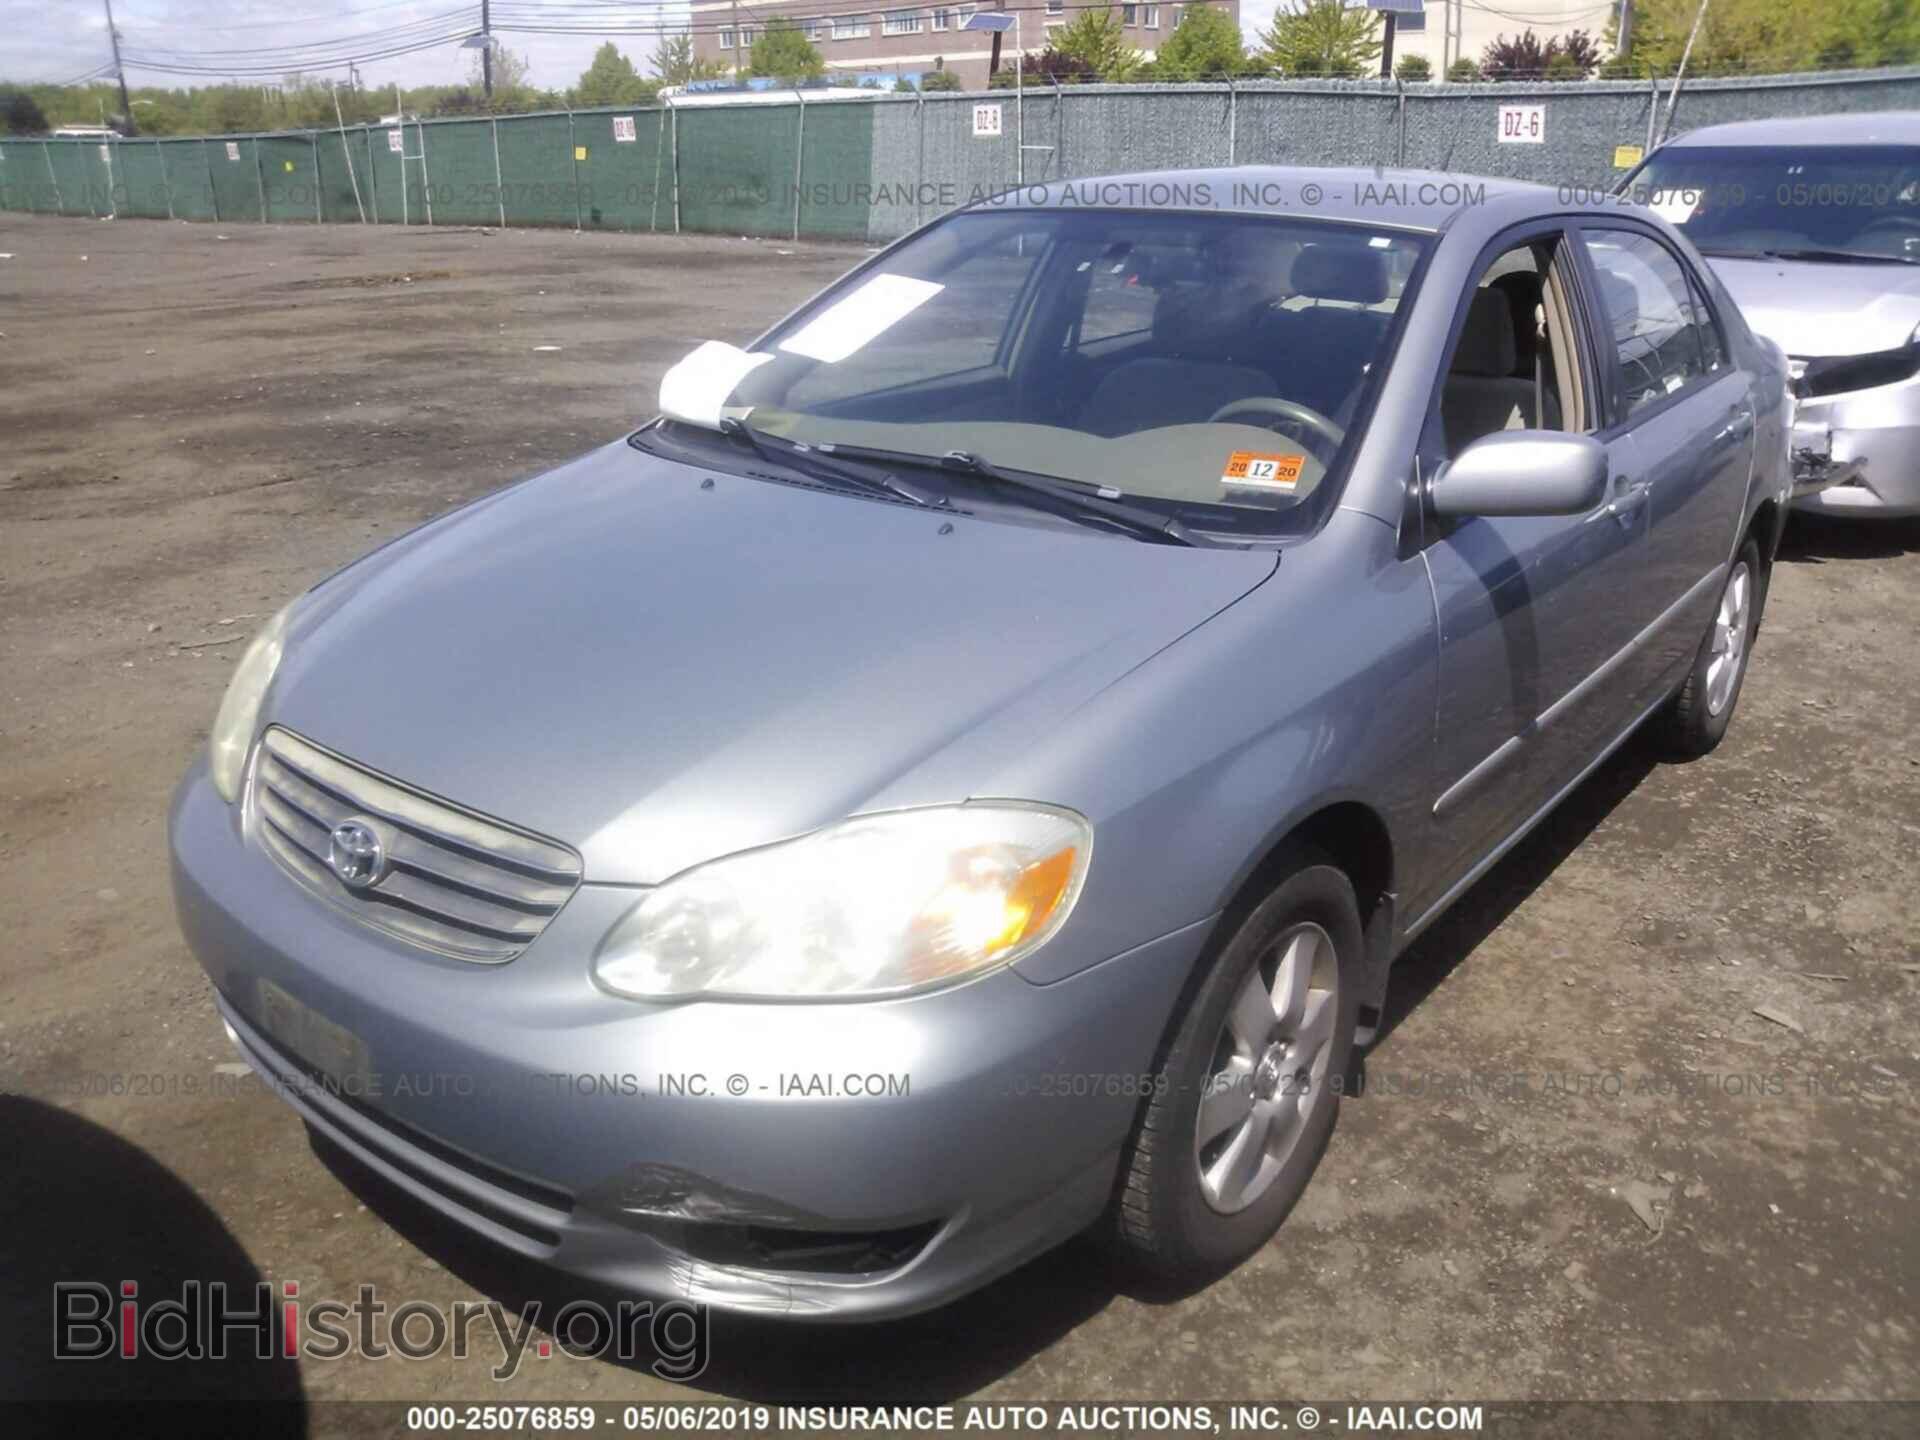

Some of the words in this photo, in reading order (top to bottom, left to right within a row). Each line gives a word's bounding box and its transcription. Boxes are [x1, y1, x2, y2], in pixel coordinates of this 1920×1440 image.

[977, 110, 998, 130] DZ-8
[1504, 111, 1539, 137] DZ-6
[1230, 462, 1248, 473] 20
[1252, 463, 1274, 477] 12
[1278, 466, 1297, 477] 20
